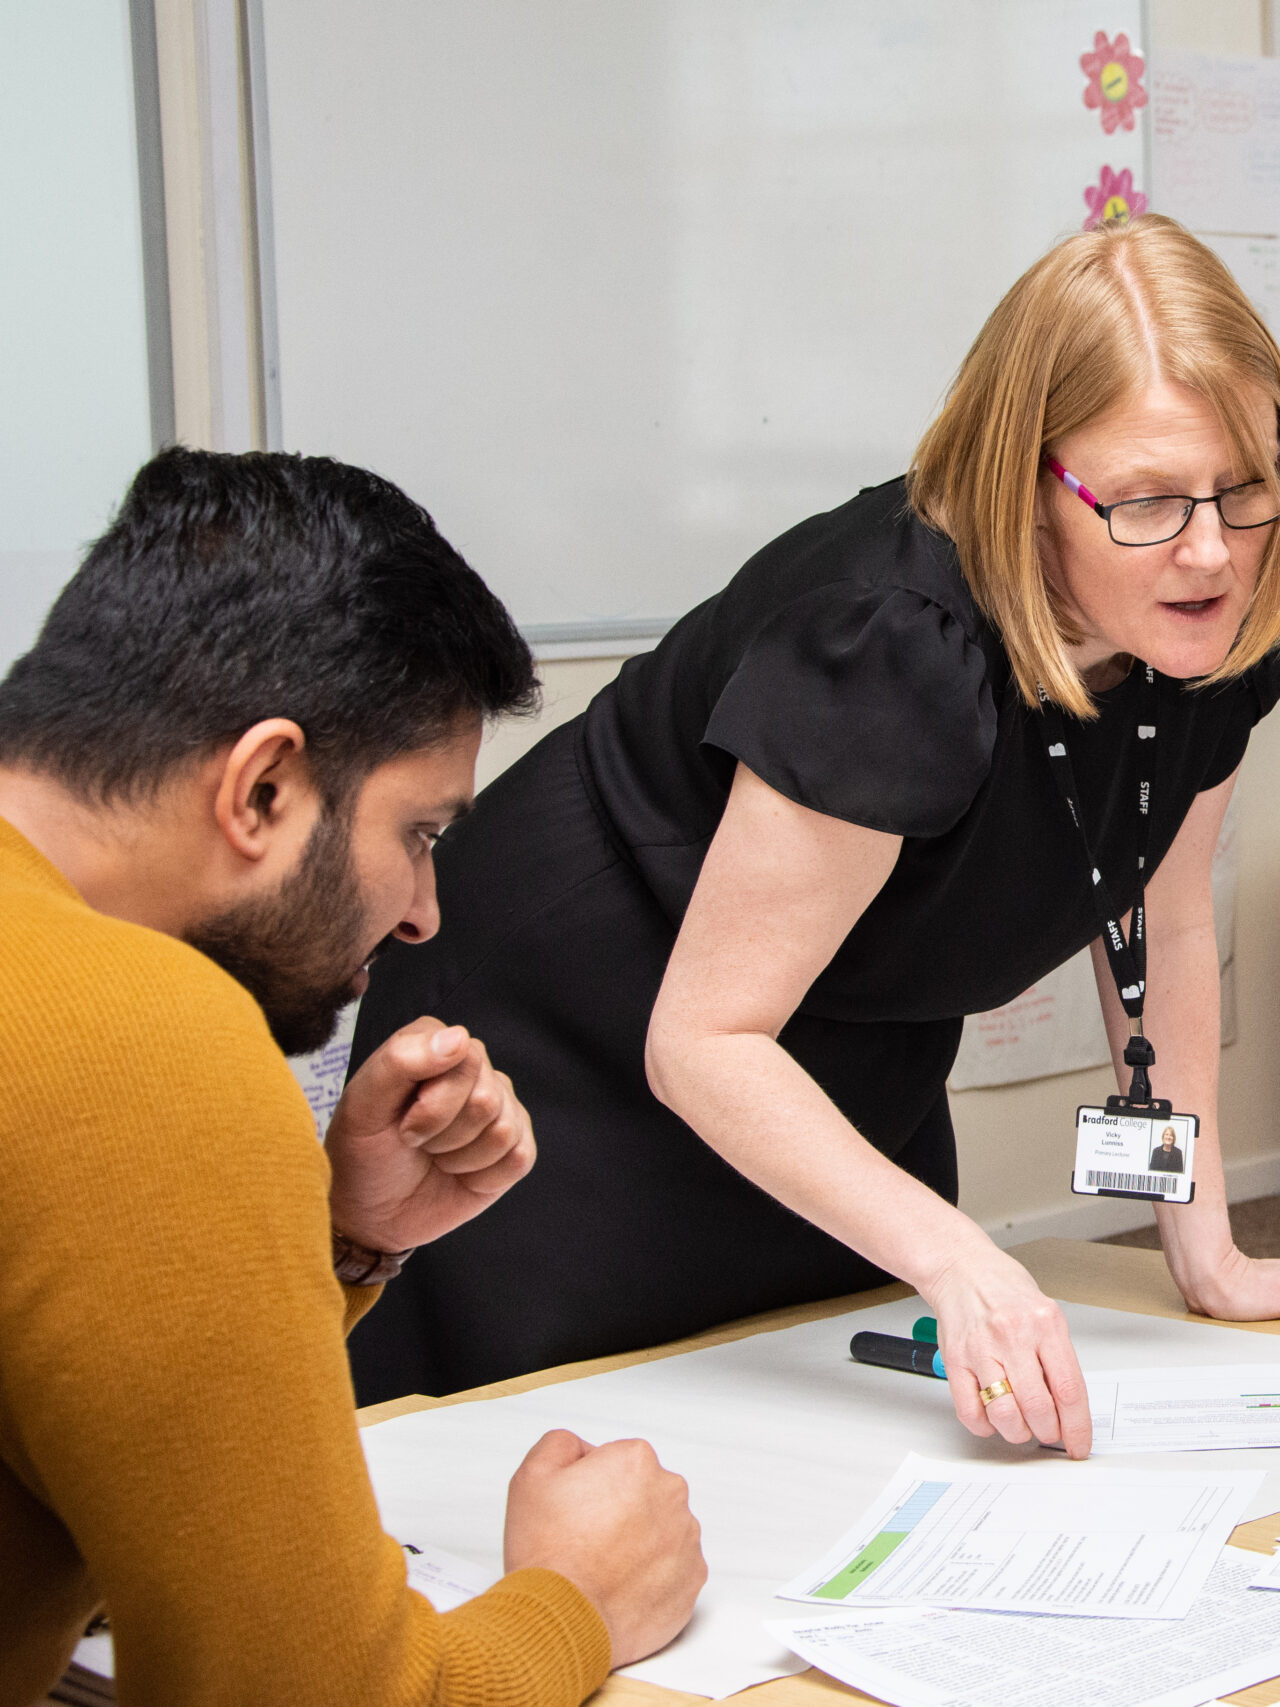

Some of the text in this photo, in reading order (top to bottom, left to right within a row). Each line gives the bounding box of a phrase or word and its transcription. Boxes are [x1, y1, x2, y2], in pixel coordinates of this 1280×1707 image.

[1139, 781, 1150, 815] STAFF
[1107, 919, 1123, 951] STAFF
[1082, 1114, 1148, 1130] Bradford College
[1105, 1131, 1122, 1139] Vicky
